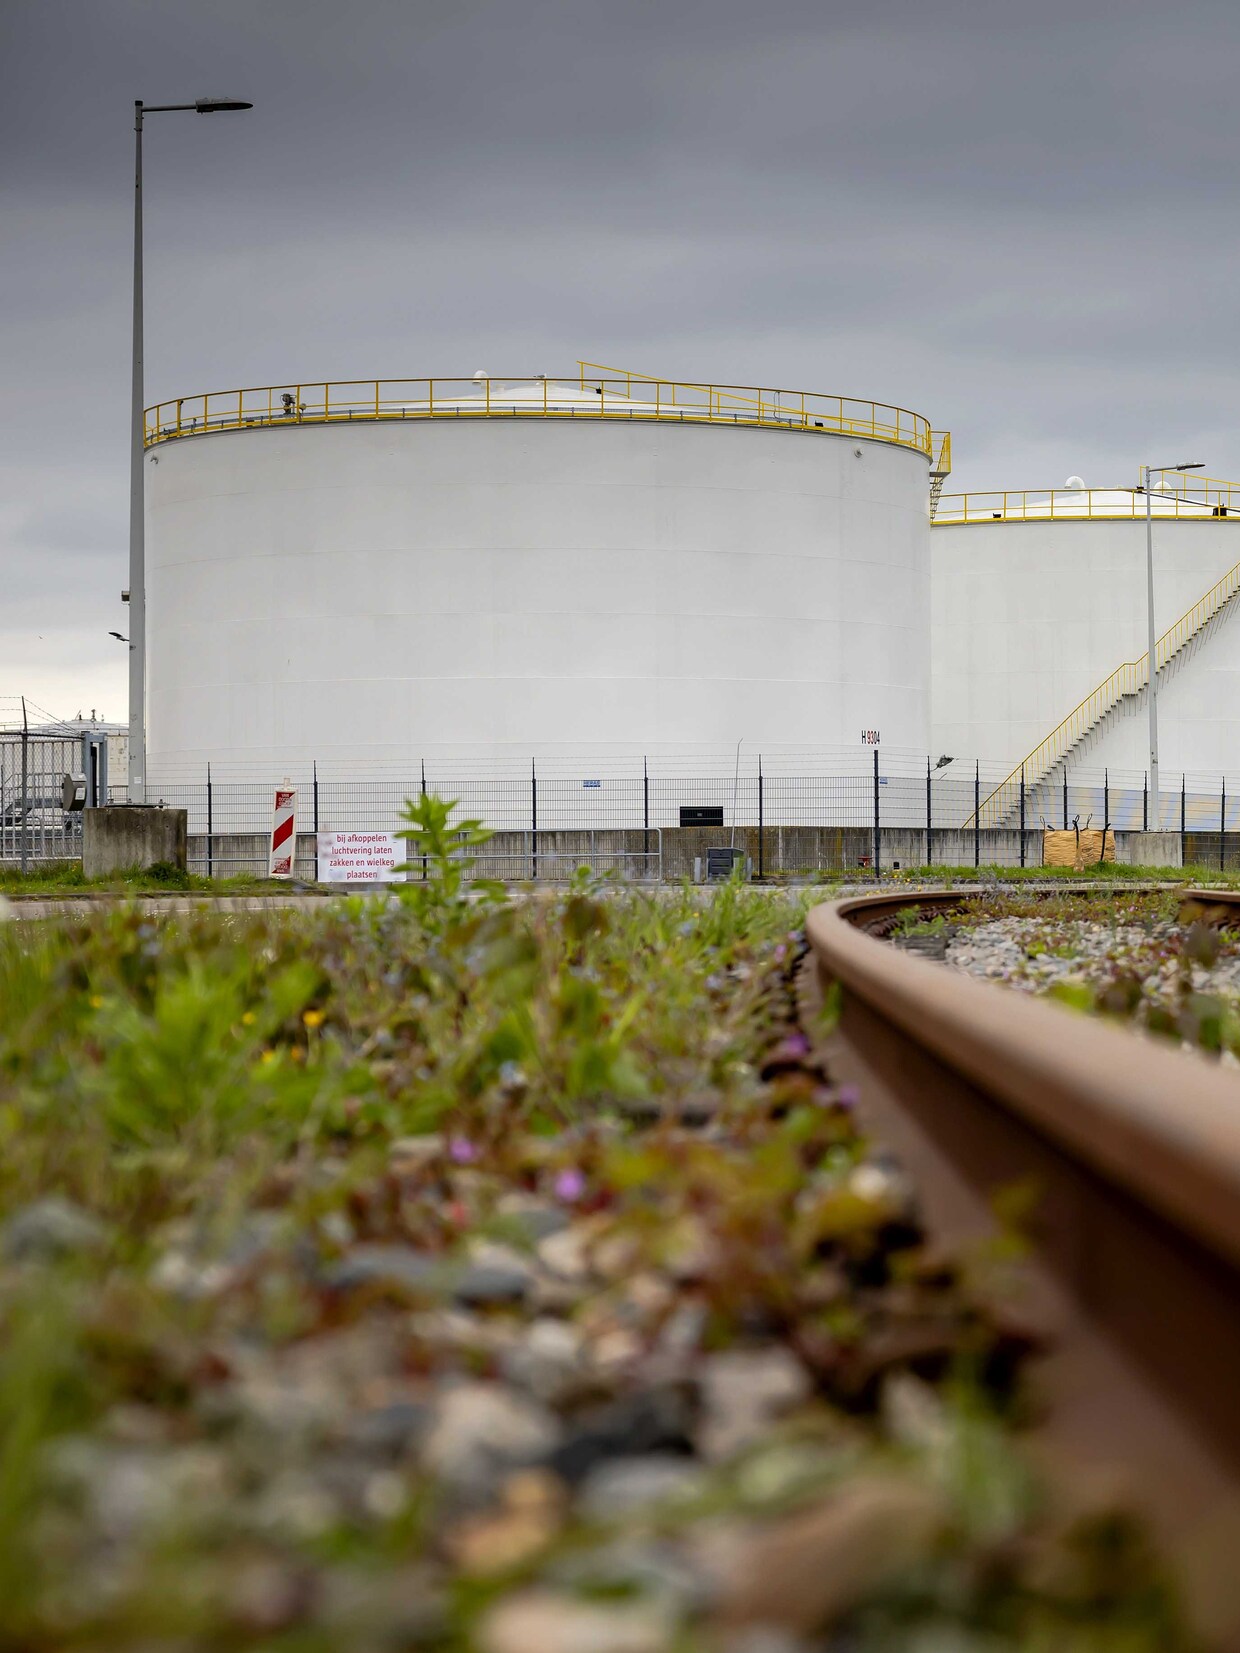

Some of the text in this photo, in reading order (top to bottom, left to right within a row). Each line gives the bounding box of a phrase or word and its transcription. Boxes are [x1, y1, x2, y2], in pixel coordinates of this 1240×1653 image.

[861, 730, 880, 744] H 9304
[337, 834, 387, 843] bij afkoppelen
[332, 846, 392, 855] luchtvering laten
[367, 858, 394, 867] wielkeg
[347, 871, 378, 879] plaatsen
